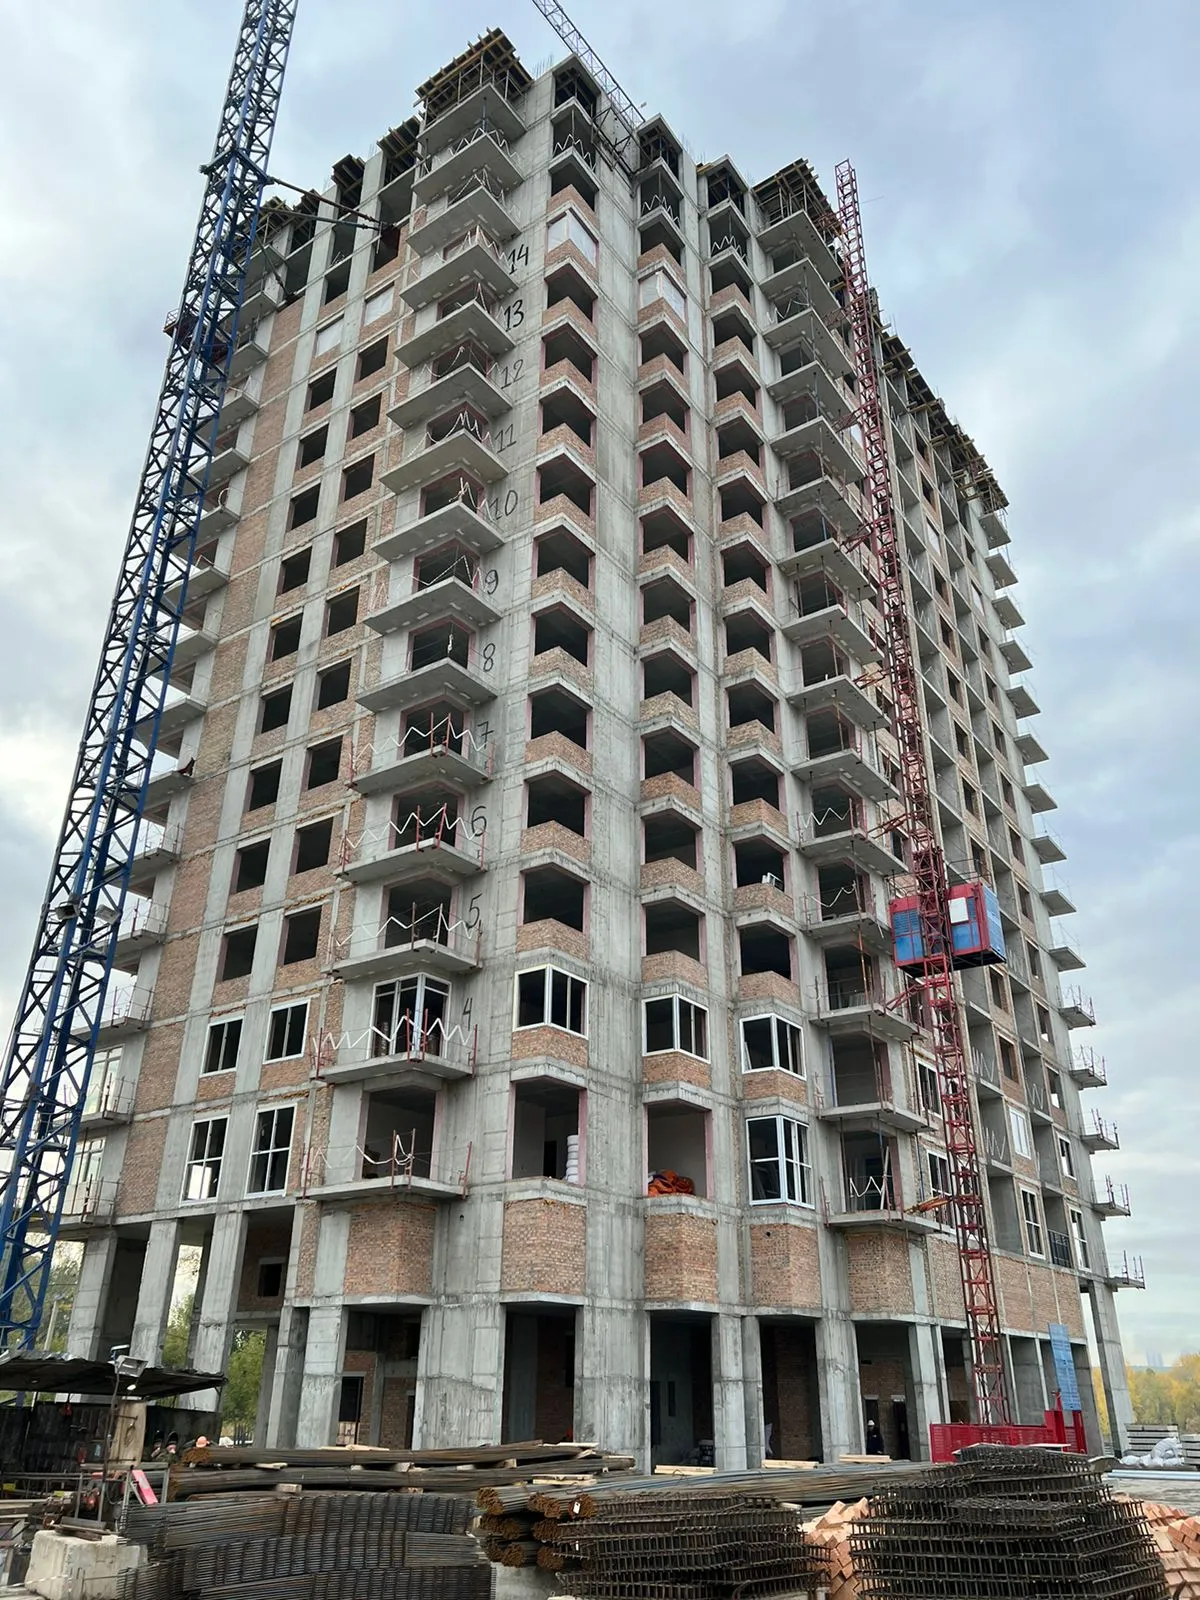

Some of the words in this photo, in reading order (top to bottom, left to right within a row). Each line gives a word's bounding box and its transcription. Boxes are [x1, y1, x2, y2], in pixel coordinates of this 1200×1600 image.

[507, 244, 529, 275] 14
[504, 299, 525, 332] 13
[501, 359, 526, 389] 12
[494, 423, 517, 454] 11
[489, 489, 519, 520] 10
[485, 569, 499, 595] 9
[483, 643, 496, 672] 8
[477, 721, 494, 749] 7
[471, 805, 487, 837] 6
[466, 893, 482, 929] 5
[462, 997, 473, 1032] 4
